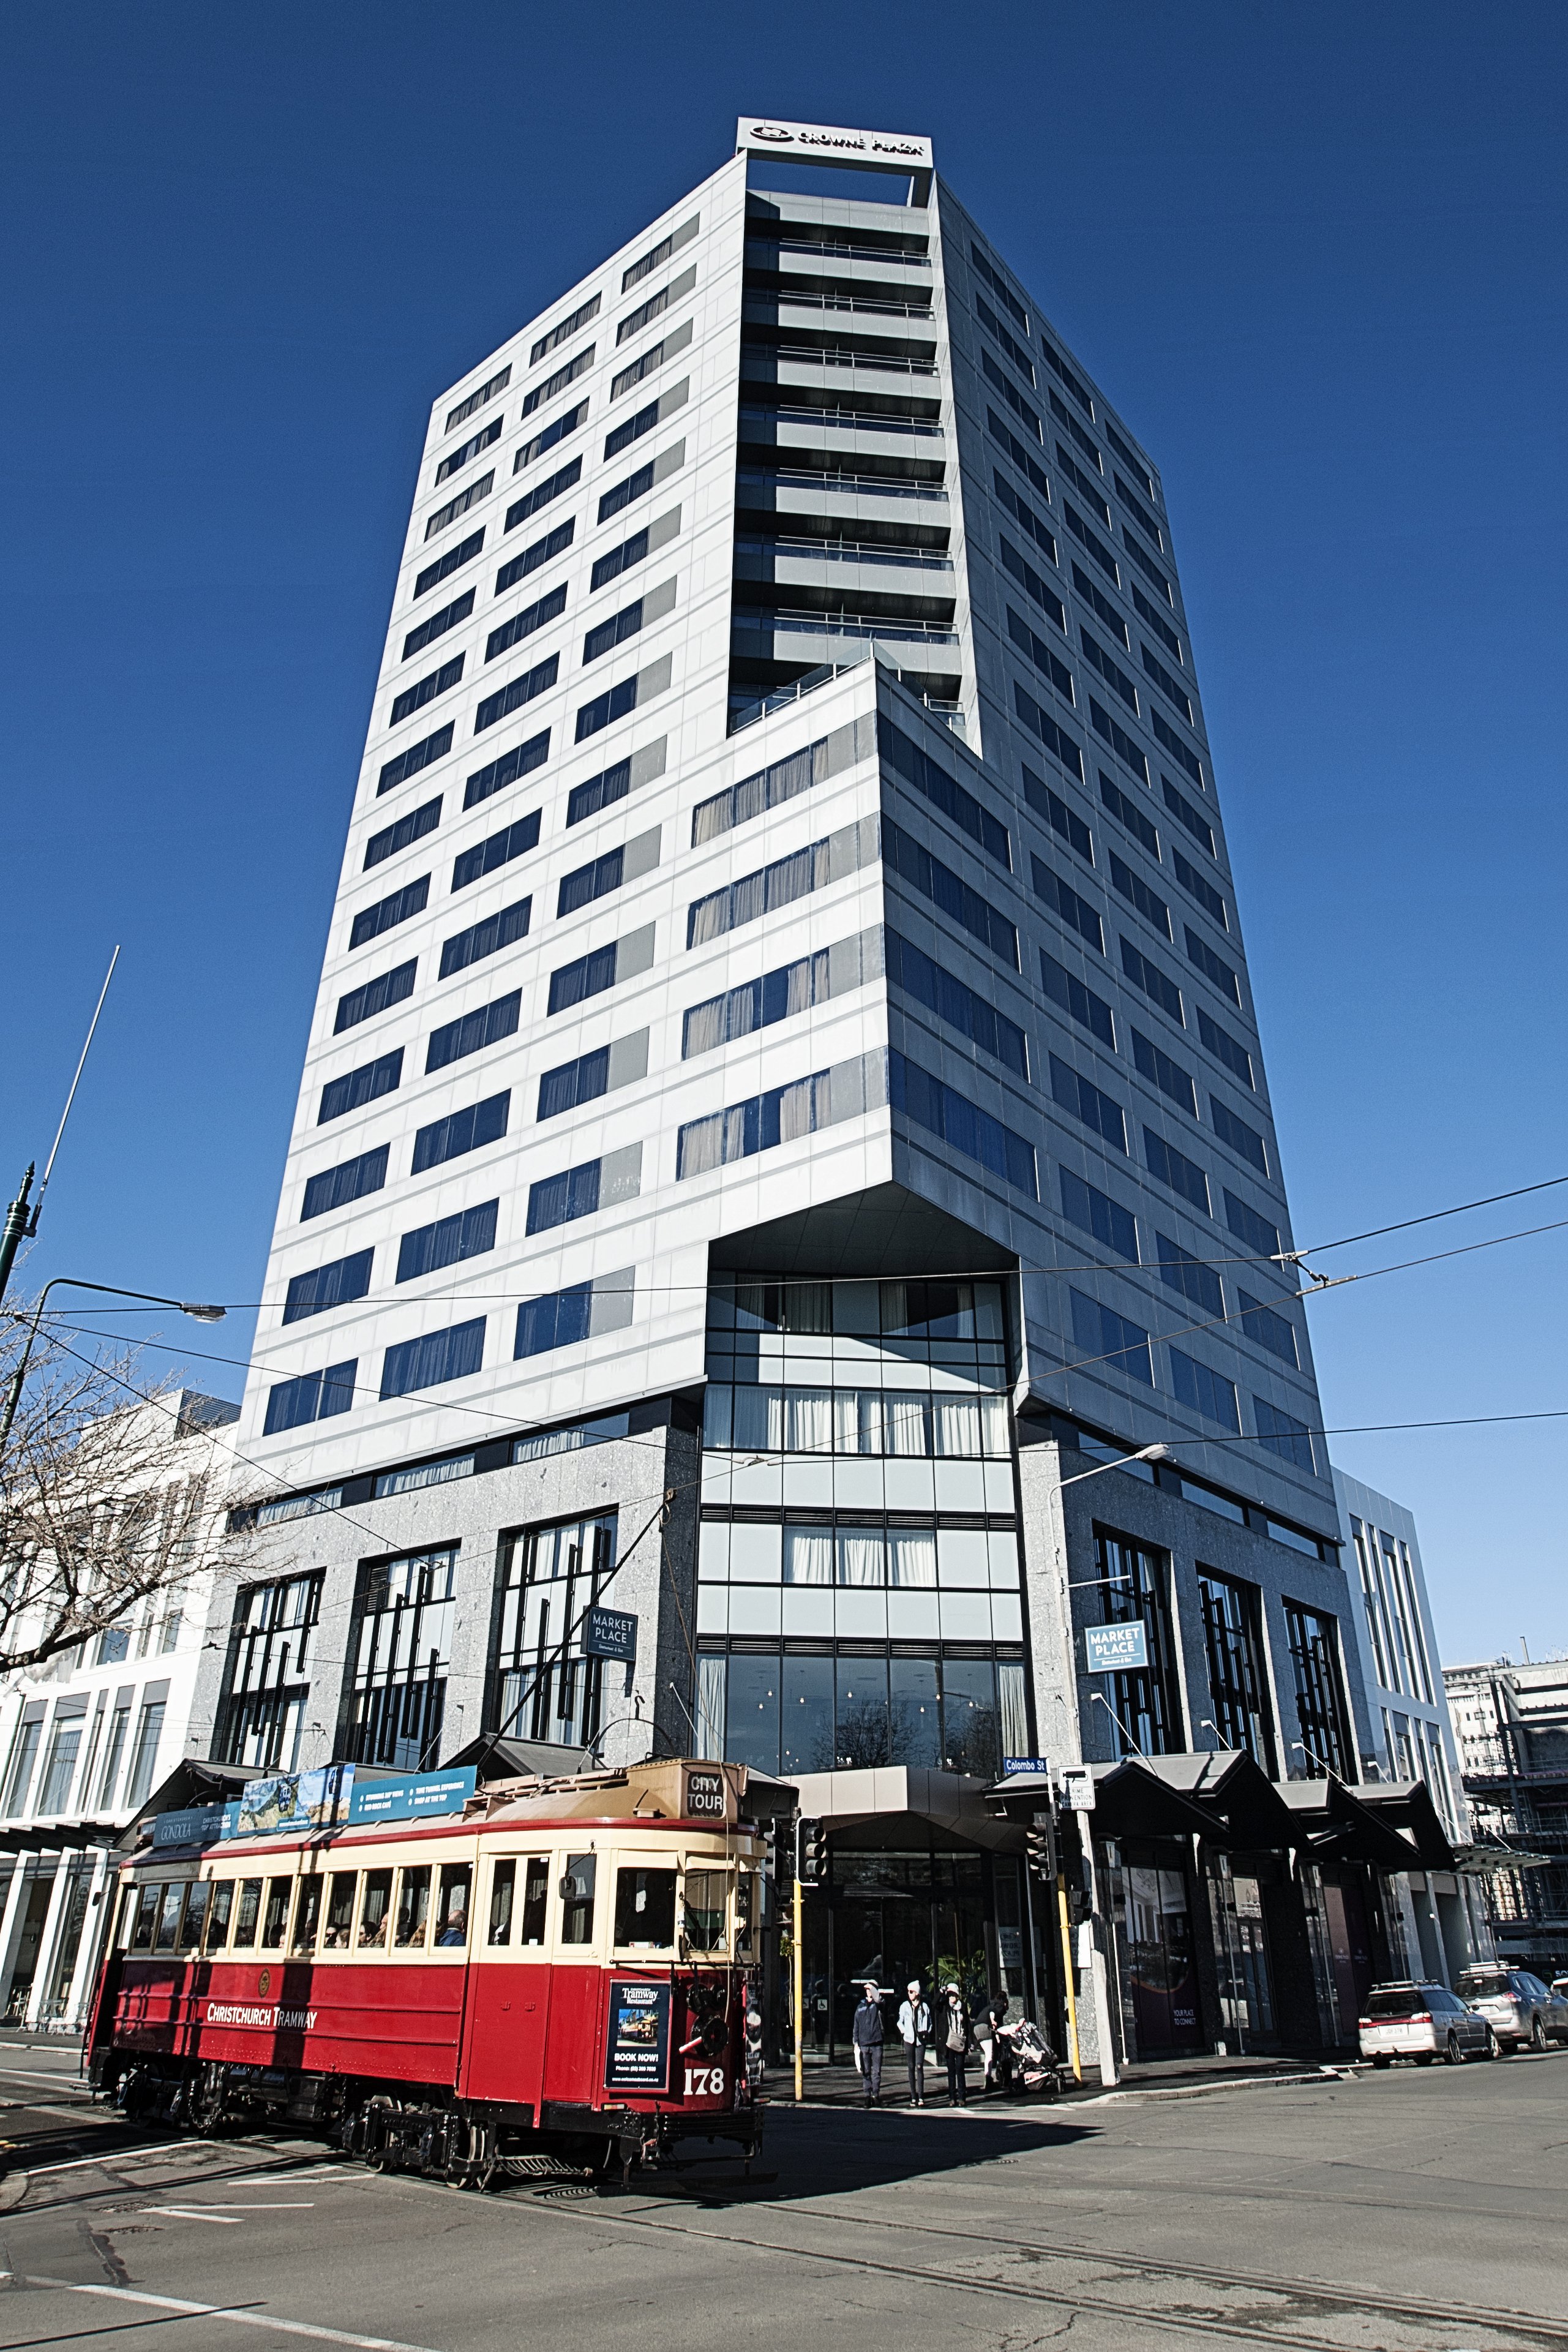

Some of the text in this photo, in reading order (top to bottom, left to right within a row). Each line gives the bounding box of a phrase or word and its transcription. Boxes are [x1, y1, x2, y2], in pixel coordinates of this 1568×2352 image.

[798, 130, 923, 152] CROWNE PLAZA
[593, 1614, 633, 1632] MARKET
[595, 1627, 627, 1644] PLACE
[1090, 1628, 1139, 1644] MARKET
[1095, 1640, 1135, 1656] PLACE
[1007, 1759, 1045, 1771] Colombo St
[691, 1776, 720, 1791] CITY
[688, 1794, 722, 1810] TOUR
[161, 1823, 191, 1840] GONDOLA
[622, 1988, 658, 2002] Tramway
[208, 2003, 317, 2029] CHRISTCHURCH TRAMWAY
[683, 2068, 724, 2095] 178
